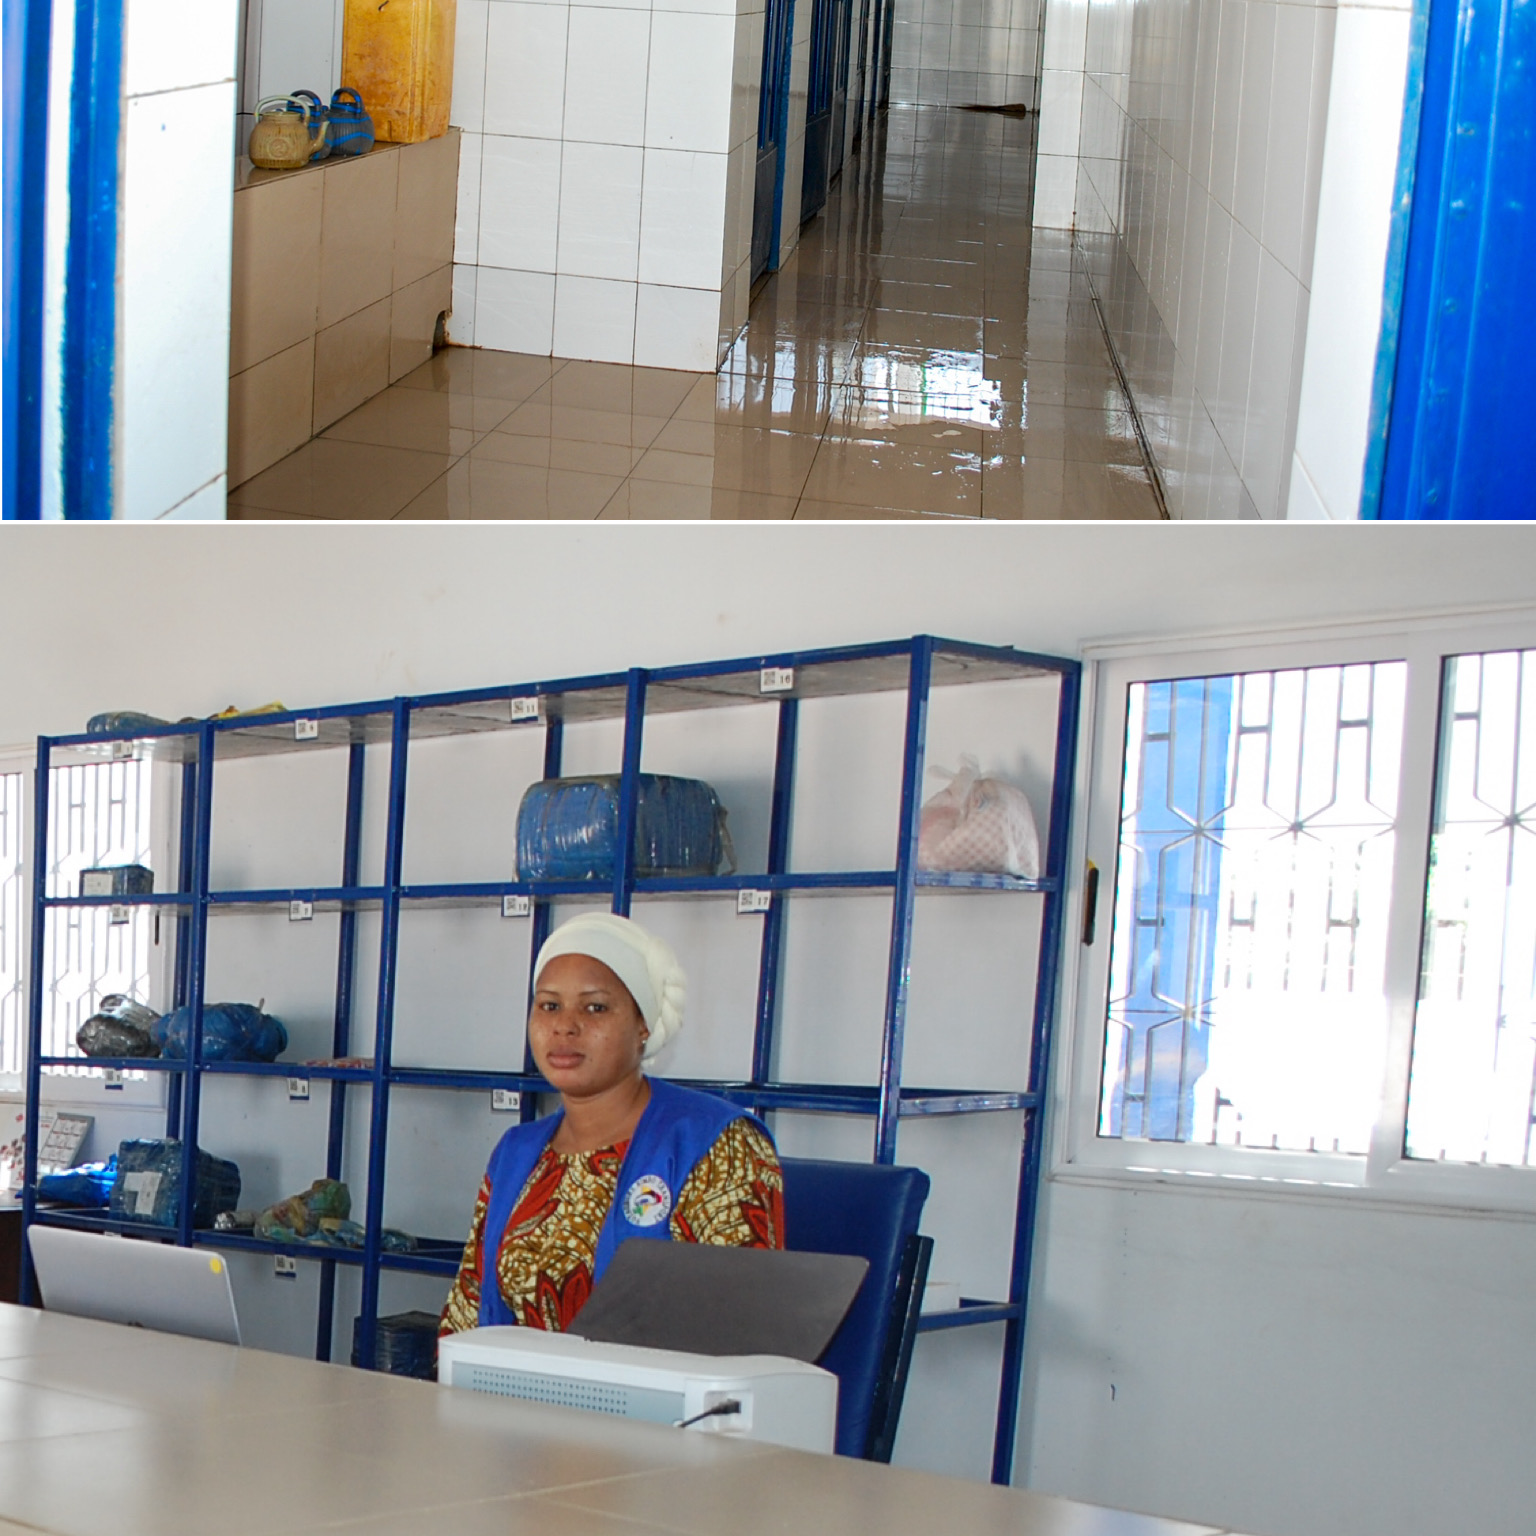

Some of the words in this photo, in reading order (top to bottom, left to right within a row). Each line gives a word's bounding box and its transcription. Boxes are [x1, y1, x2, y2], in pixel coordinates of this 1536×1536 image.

[780, 674, 791, 684] 16
[526, 703, 535, 713] 11
[758, 896, 769, 906] 17
[508, 1096, 518, 1106] 13
